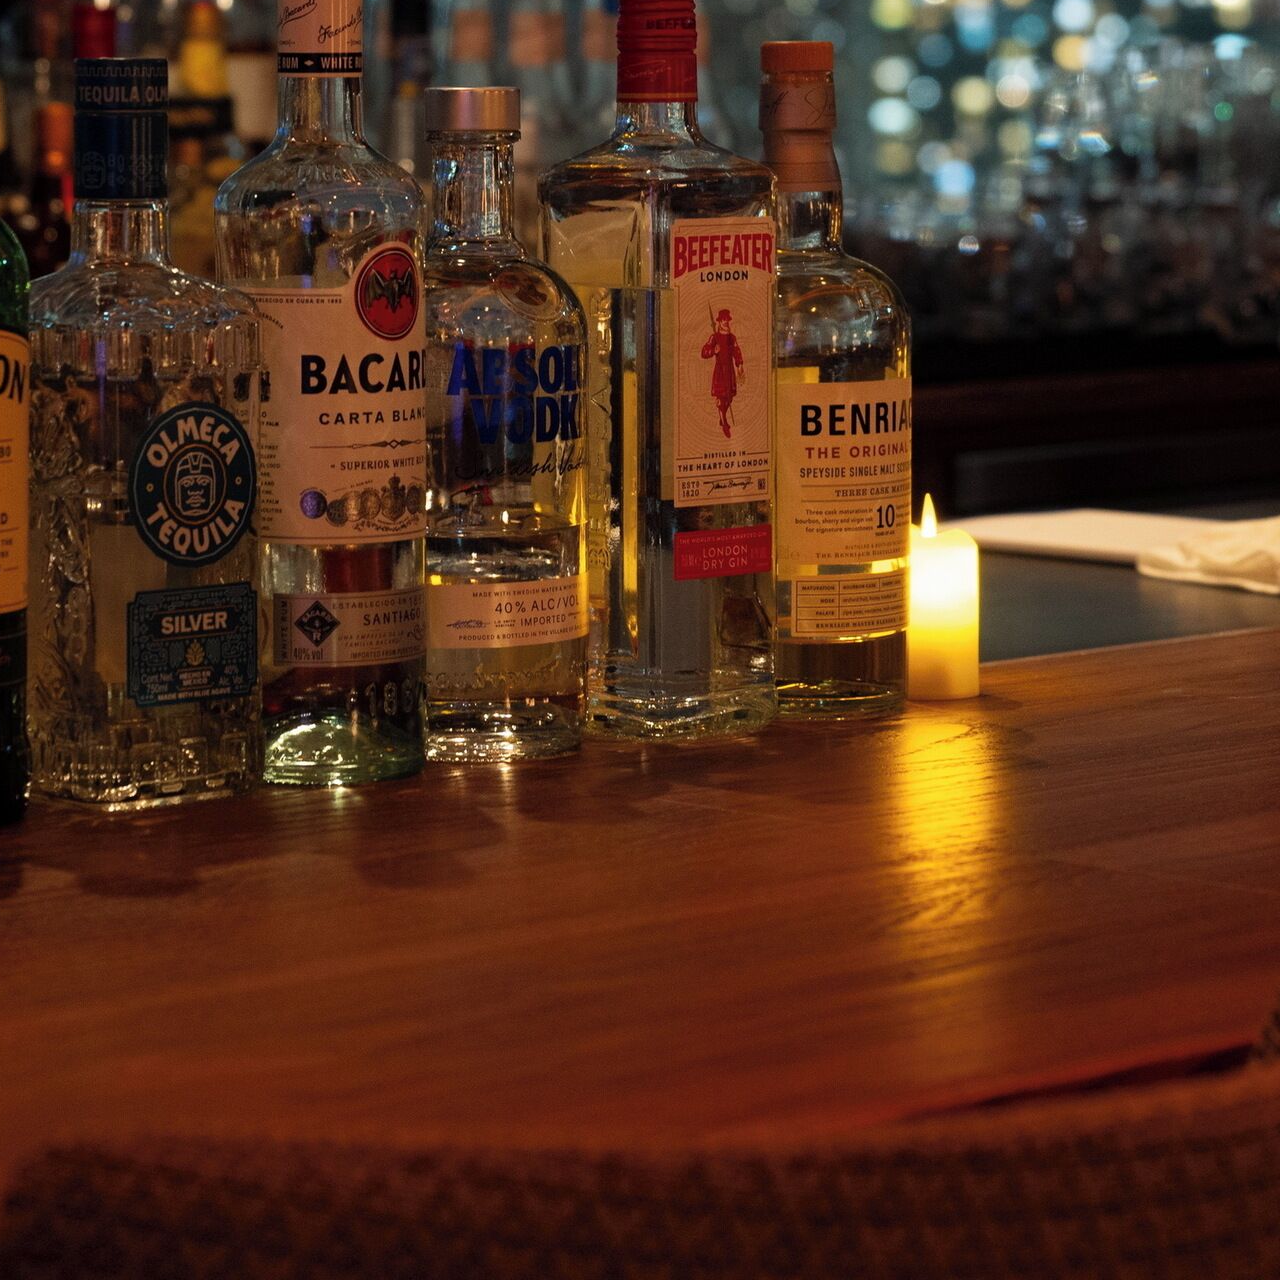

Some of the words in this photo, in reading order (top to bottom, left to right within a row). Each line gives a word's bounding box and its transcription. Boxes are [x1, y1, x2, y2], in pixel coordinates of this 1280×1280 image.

[320, 56, 354, 70] WHITE
[79, 84, 140, 104] TEQUILA
[674, 233, 773, 279] BEEFEATER
[700, 270, 749, 283] LONDON
[319, 411, 386, 426] CARTA
[471, 393, 581, 445] VODK
[146, 415, 241, 468] OLMECA
[703, 450, 737, 460] DISTILLED
[739, 450, 746, 458] IN
[805, 446, 841, 459] THE
[849, 441, 908, 458] ORIGINAL
[340, 459, 391, 471] SUPERIOR
[392, 456, 416, 469] WHITE
[678, 464, 693, 473] THE
[696, 462, 722, 471] HEART
[724, 461, 735, 469] OF
[737, 458, 769, 468] LONDON
[800, 467, 846, 479] SPEYSIDE
[849, 465, 878, 478] SINGLE
[880, 463, 896, 475] MALT
[682, 489, 700, 498] 1820
[834, 488, 867, 498] THREE
[869, 486, 890, 496] CASK
[876, 503, 895, 529] 10
[146, 498, 245, 556] TEQUILA
[702, 543, 749, 559] LONDON
[702, 558, 725, 571] DRY
[728, 556, 748, 568] GIN
[513, 588, 540, 596] SWEDISH
[332, 598, 396, 610] ESTABLECIDO
[494, 601, 527, 614] 40%
[160, 610, 229, 635] SILVER
[363, 608, 421, 626] SANTIAGO
[520, 614, 566, 627] IMPORTED
[458, 633, 495, 641] PRODUCED
